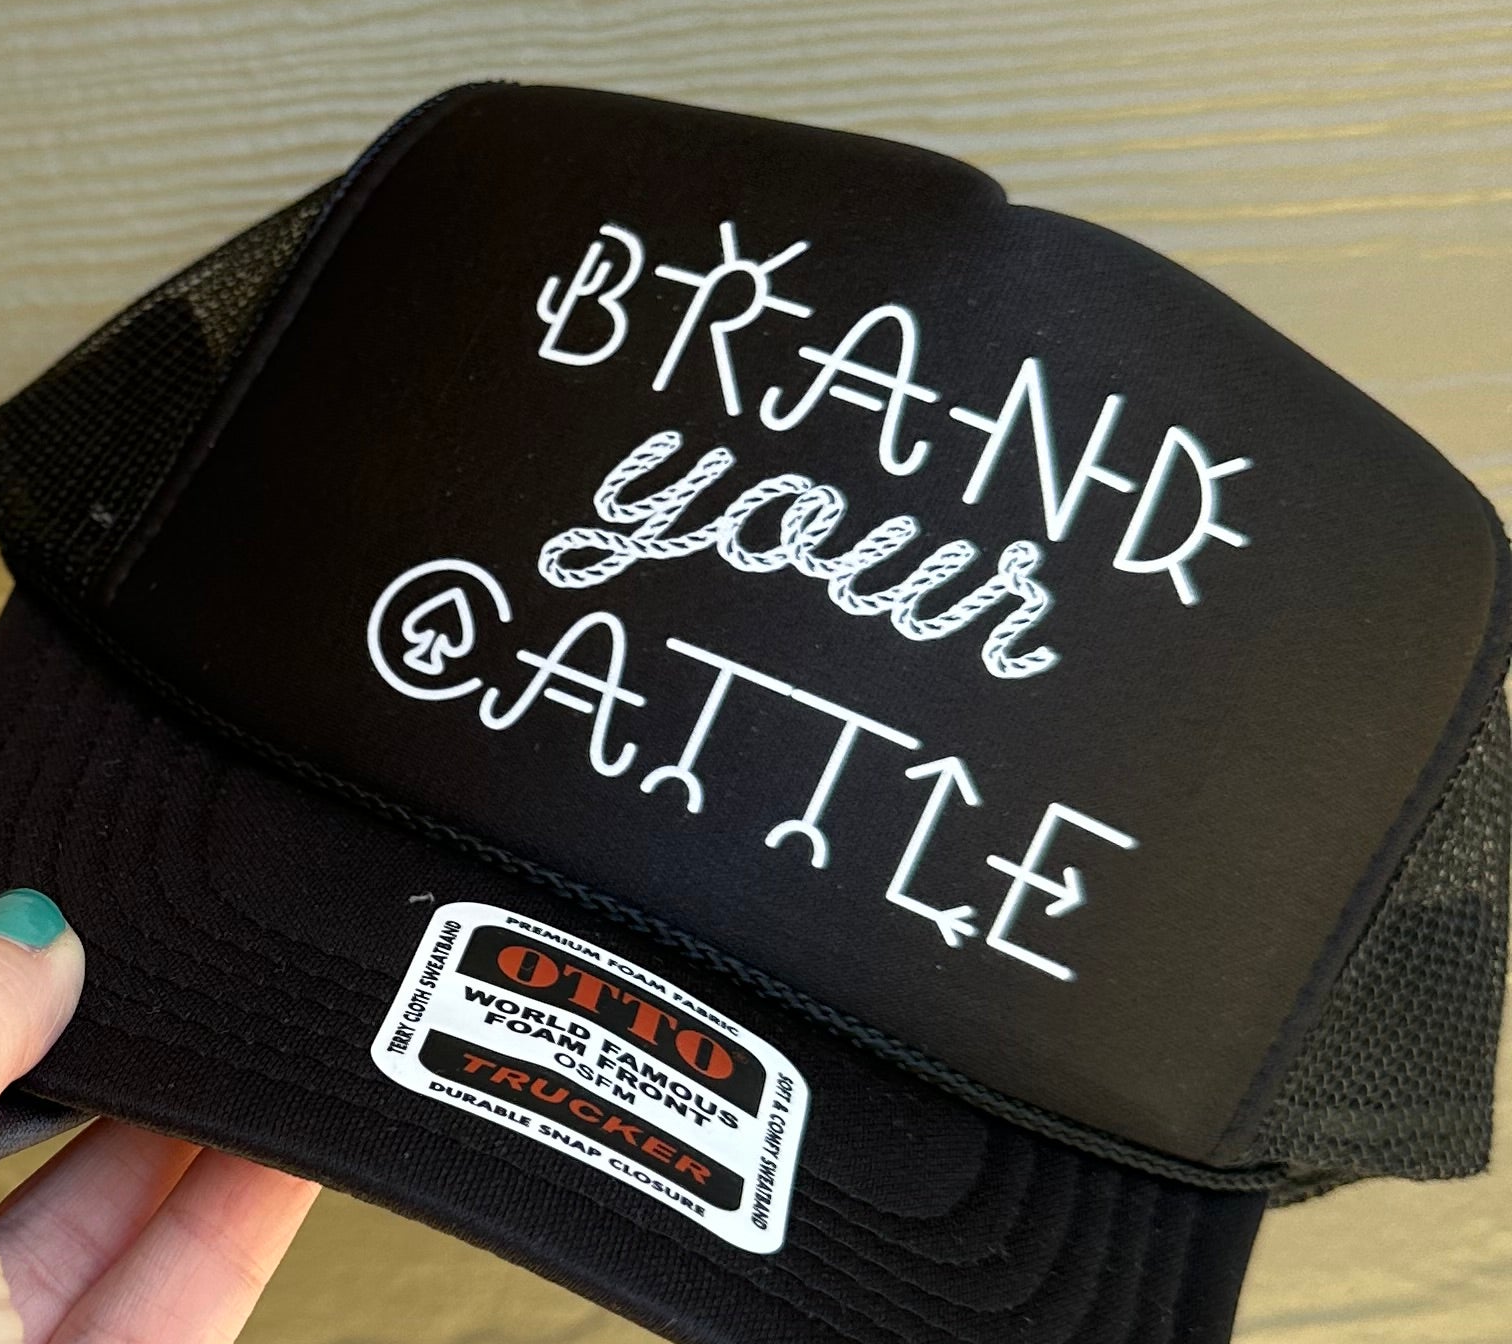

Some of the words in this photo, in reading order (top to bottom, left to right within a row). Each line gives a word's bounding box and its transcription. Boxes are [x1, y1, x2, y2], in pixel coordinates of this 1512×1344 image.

[536, 220, 1251, 606] BRAND
[537, 430, 1060, 680] your
[366, 557, 1140, 982] CATTLE
[387, 1022, 416, 1055] TERRY
[403, 988, 432, 1023] CLOTH
[419, 920, 462, 989] SWEATBAND
[497, 945, 734, 1079] OTTO
[505, 916, 601, 960] PREMIUM
[607, 959, 666, 994] FOAM
[672, 992, 740, 1037] FABRIC
[463, 1053, 712, 1185] TRUCKER
[464, 985, 591, 1040] WORLD
[601, 1039, 739, 1129] FAMOUS
[484, 1011, 587, 1057] FOAM
[596, 1054, 711, 1127] FRONT
[554, 1052, 636, 1105] OSFM
[775, 1072, 794, 1104] SOFT
[429, 1081, 532, 1127] DURABLE
[538, 1124, 602, 1157] SNAP
[608, 1158, 706, 1218] CLOSURE
[750, 1156, 777, 1230] SWEATBAND
[762, 1114, 786, 1160] COMFY
